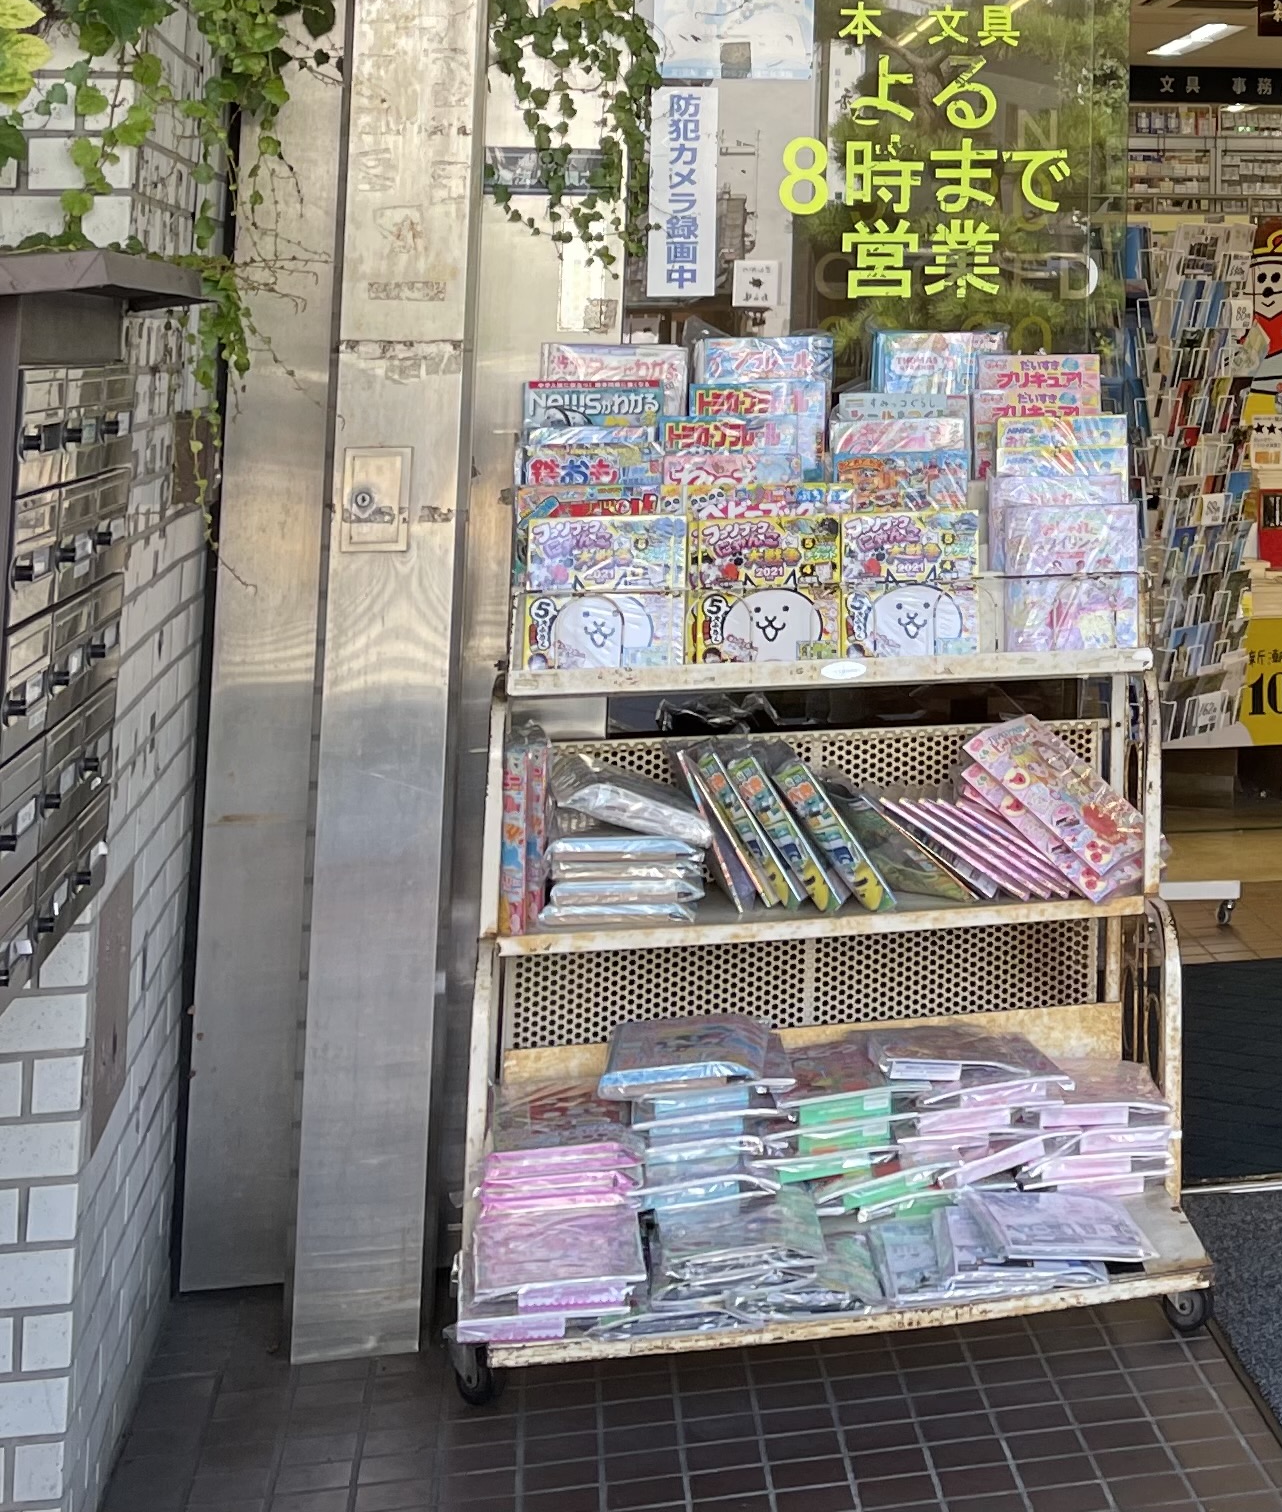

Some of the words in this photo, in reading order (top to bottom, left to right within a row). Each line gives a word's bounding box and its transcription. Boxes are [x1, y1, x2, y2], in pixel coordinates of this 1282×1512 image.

[839, 2, 882, 45] 本
[927, 4, 1020, 47] 文具
[850, 54, 998, 129] よる
[1159, 75, 1201, 94] 文具
[664, 92, 702, 291] 防犯カメラ録画中
[778, 134, 1072, 215] 8時まで
[841, 218, 1000, 299] 営業
[754, 565, 784, 578] 2021
[895, 561, 926, 573] 2021
